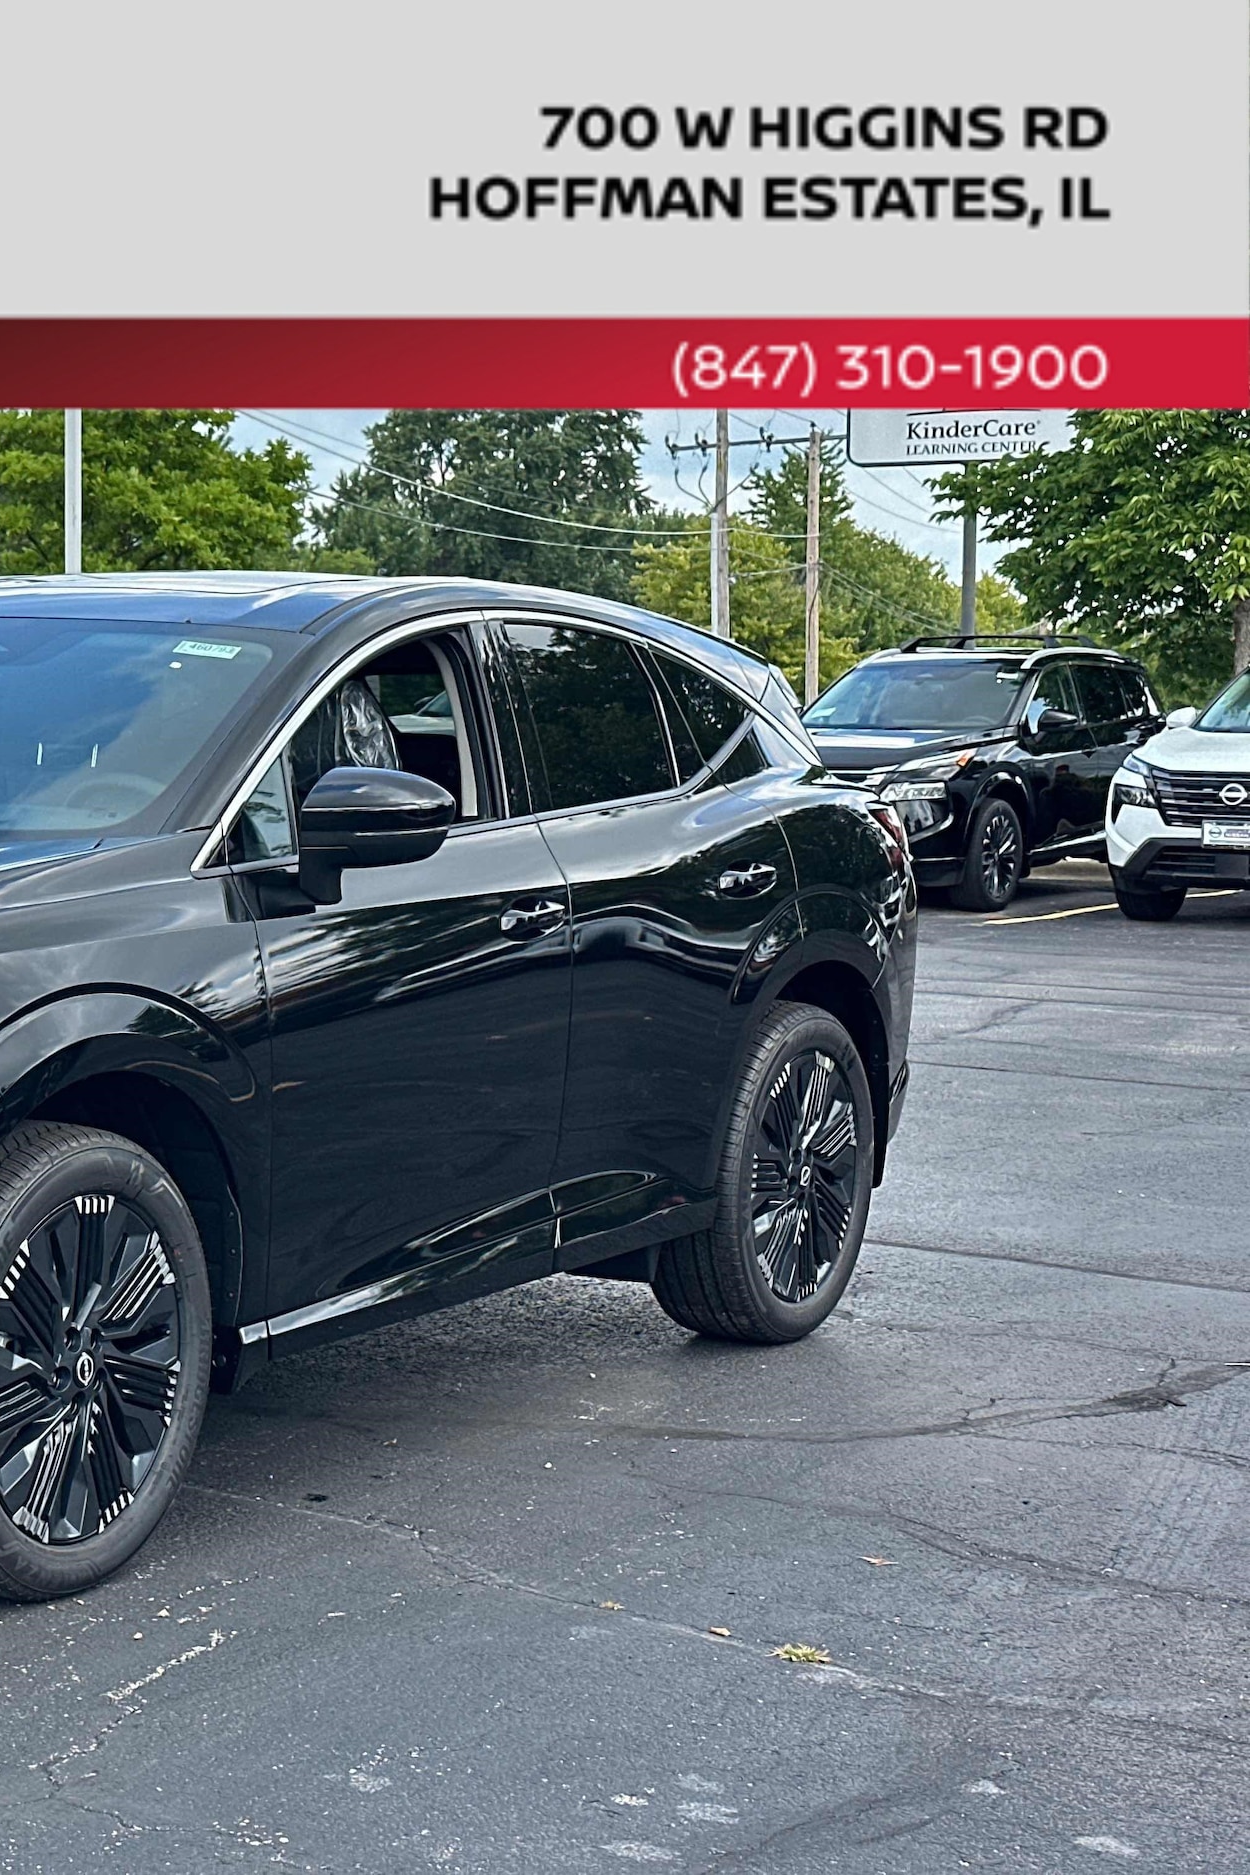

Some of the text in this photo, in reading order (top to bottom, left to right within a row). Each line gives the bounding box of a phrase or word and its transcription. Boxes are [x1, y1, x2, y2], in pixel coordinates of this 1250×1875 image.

[906, 418, 1036, 440] KinderCare
[906, 440, 1036, 456] LEARNING CENTER
